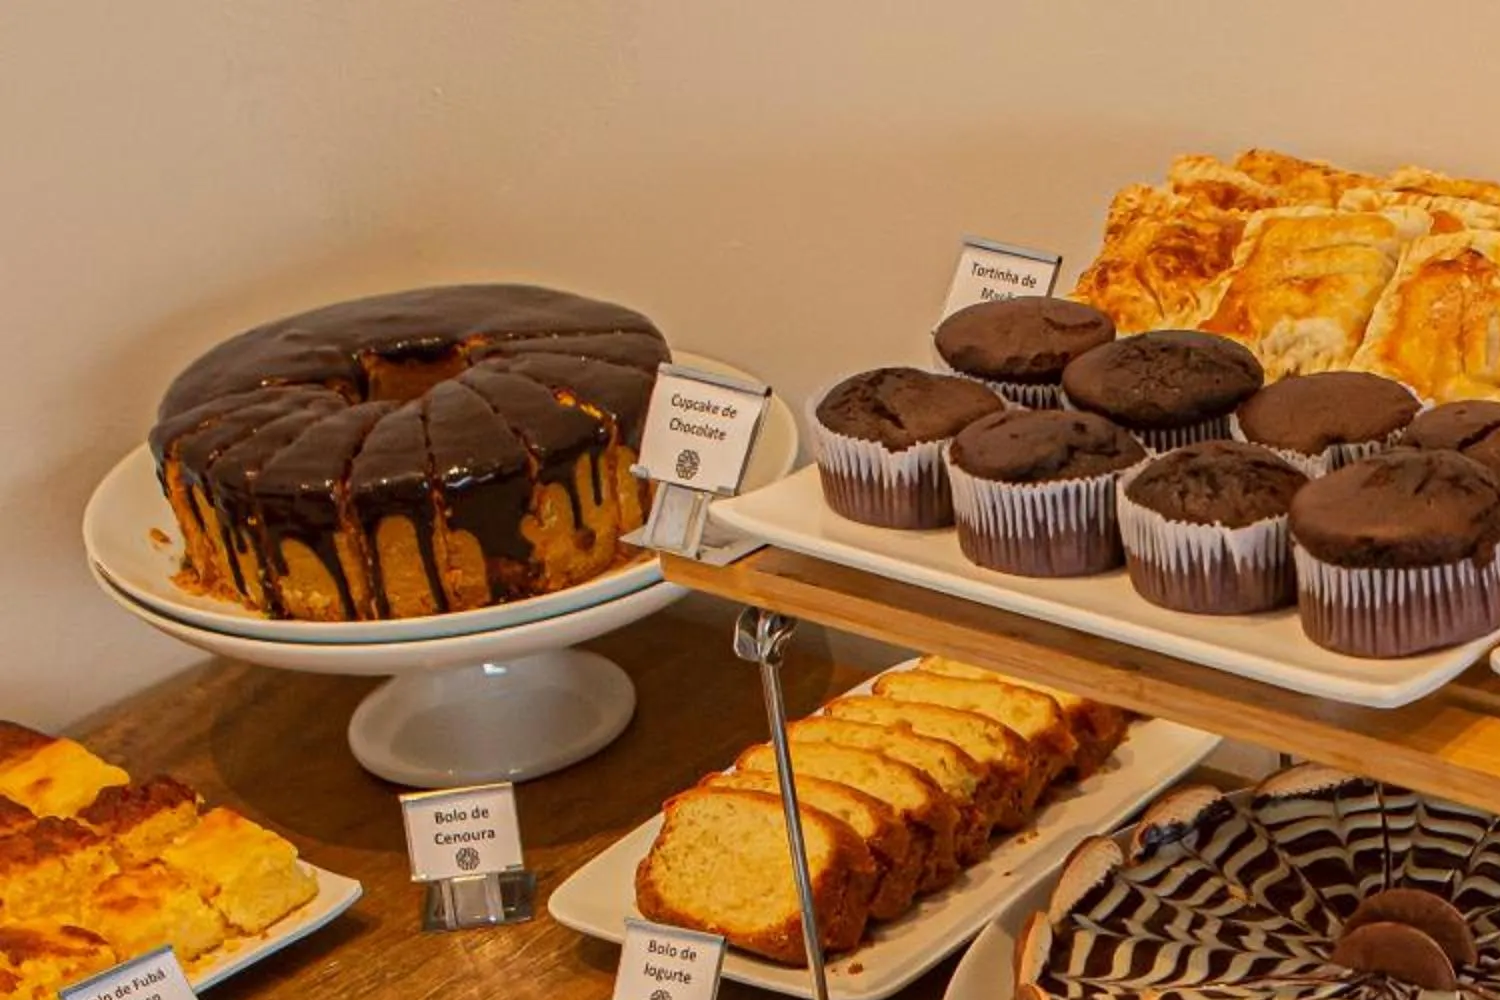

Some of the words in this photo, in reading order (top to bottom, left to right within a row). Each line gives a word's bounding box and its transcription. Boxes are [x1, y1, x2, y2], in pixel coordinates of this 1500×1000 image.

[971, 262, 1019, 285] Tortinha
[1021, 273, 1038, 289] de
[671, 393, 719, 416] Cupcake
[721, 404, 738, 419] de
[669, 417, 727, 442] Chocolate
[434, 808, 468, 825] Bolo
[470, 804, 490, 820] de
[434, 828, 496, 845] Cenoura
[648, 940, 678, 958] Bolo
[680, 945, 698, 962] de
[115, 983, 132, 1000] de
[131, 967, 167, 991] Fubá
[643, 961, 693, 985] Iogurte
